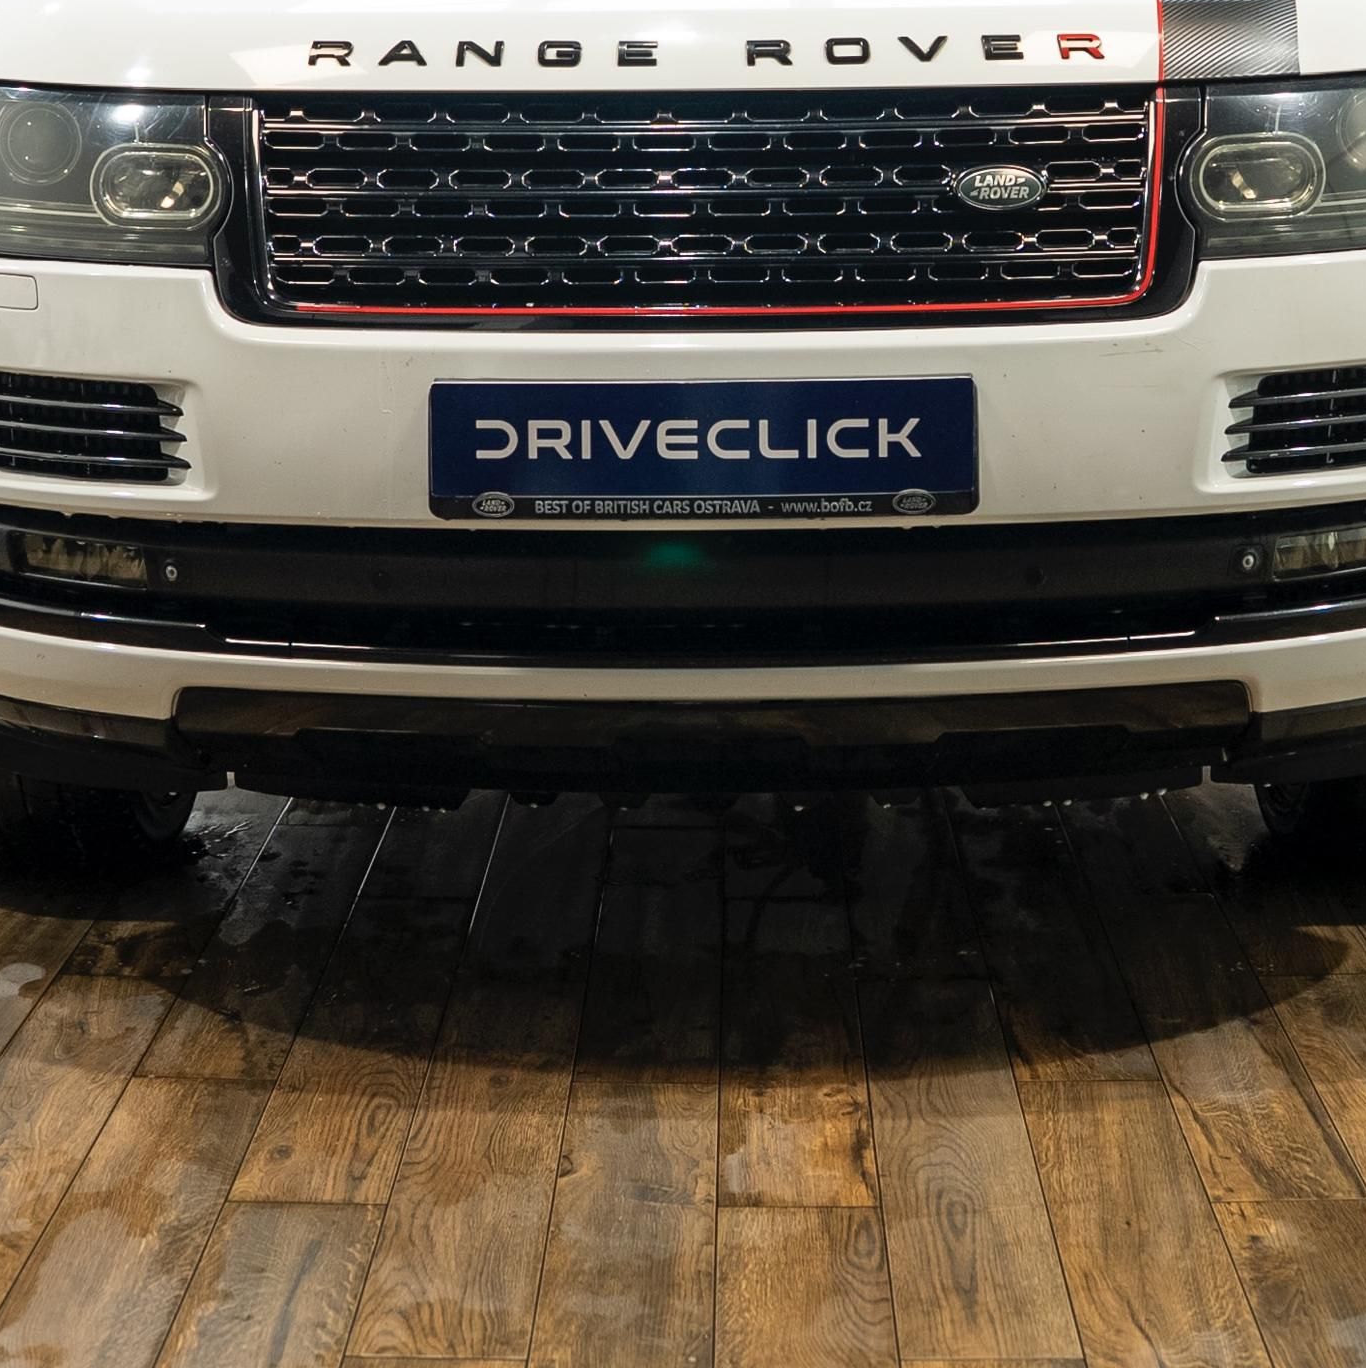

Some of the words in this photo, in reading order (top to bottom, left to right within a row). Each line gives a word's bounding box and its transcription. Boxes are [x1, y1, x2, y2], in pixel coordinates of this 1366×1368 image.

[307, 39, 660, 68] RANGE
[746, 33, 1107, 67] ROVER
[974, 175, 1016, 187] LAND
[978, 186, 1030, 200] ROVER
[475, 417, 922, 461] DRIVECLICK
[535, 500, 569, 514] BEST
[571, 500, 591, 514] OF
[594, 500, 649, 514] BRITISH
[653, 500, 691, 514] CARS
[694, 499, 761, 514] OSTRAVA
[781, 497, 873, 514] www.bofb.cz
